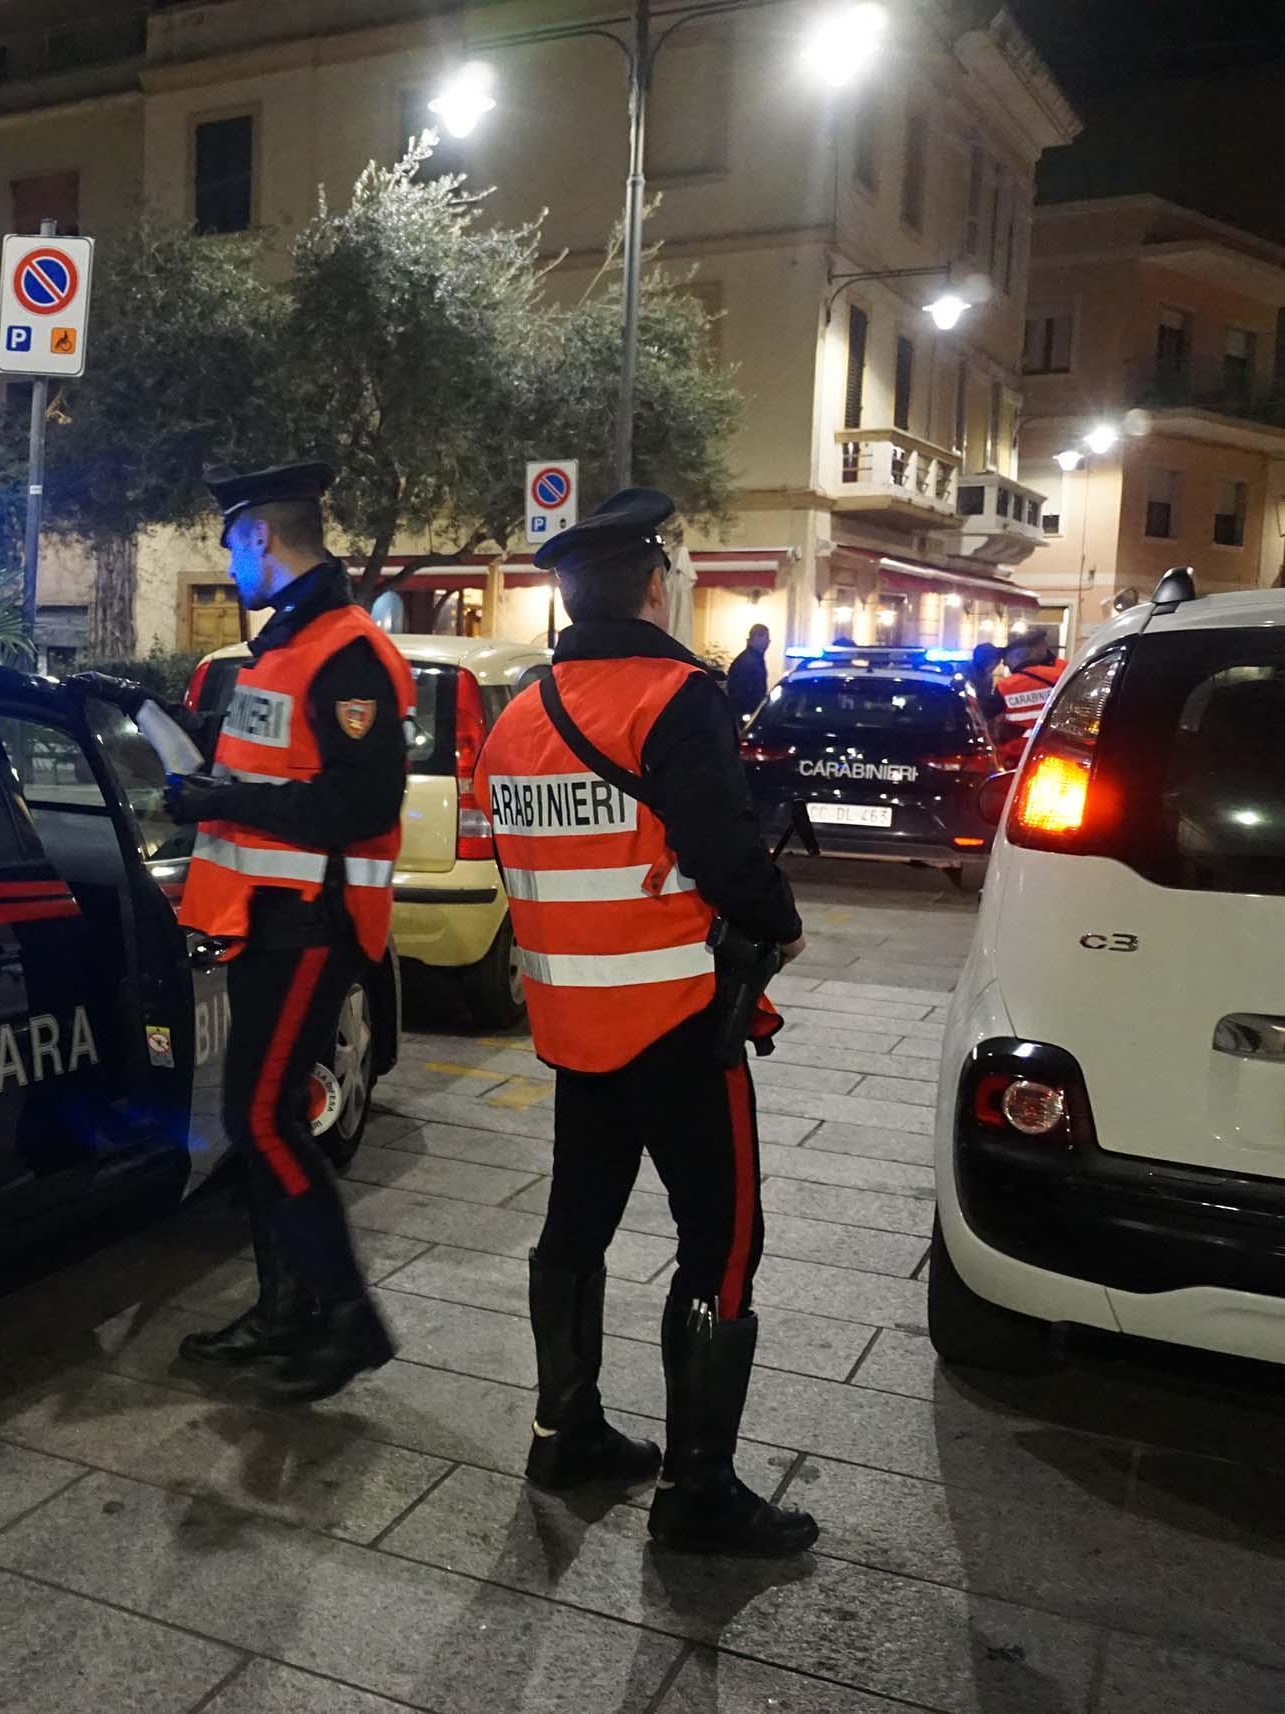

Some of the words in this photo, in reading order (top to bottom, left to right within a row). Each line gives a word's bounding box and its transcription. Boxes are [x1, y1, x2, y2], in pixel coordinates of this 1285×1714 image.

[11, 328, 27, 348] P
[799, 759, 917, 781] CARABINIERI
[1079, 933, 1139, 952] C3
